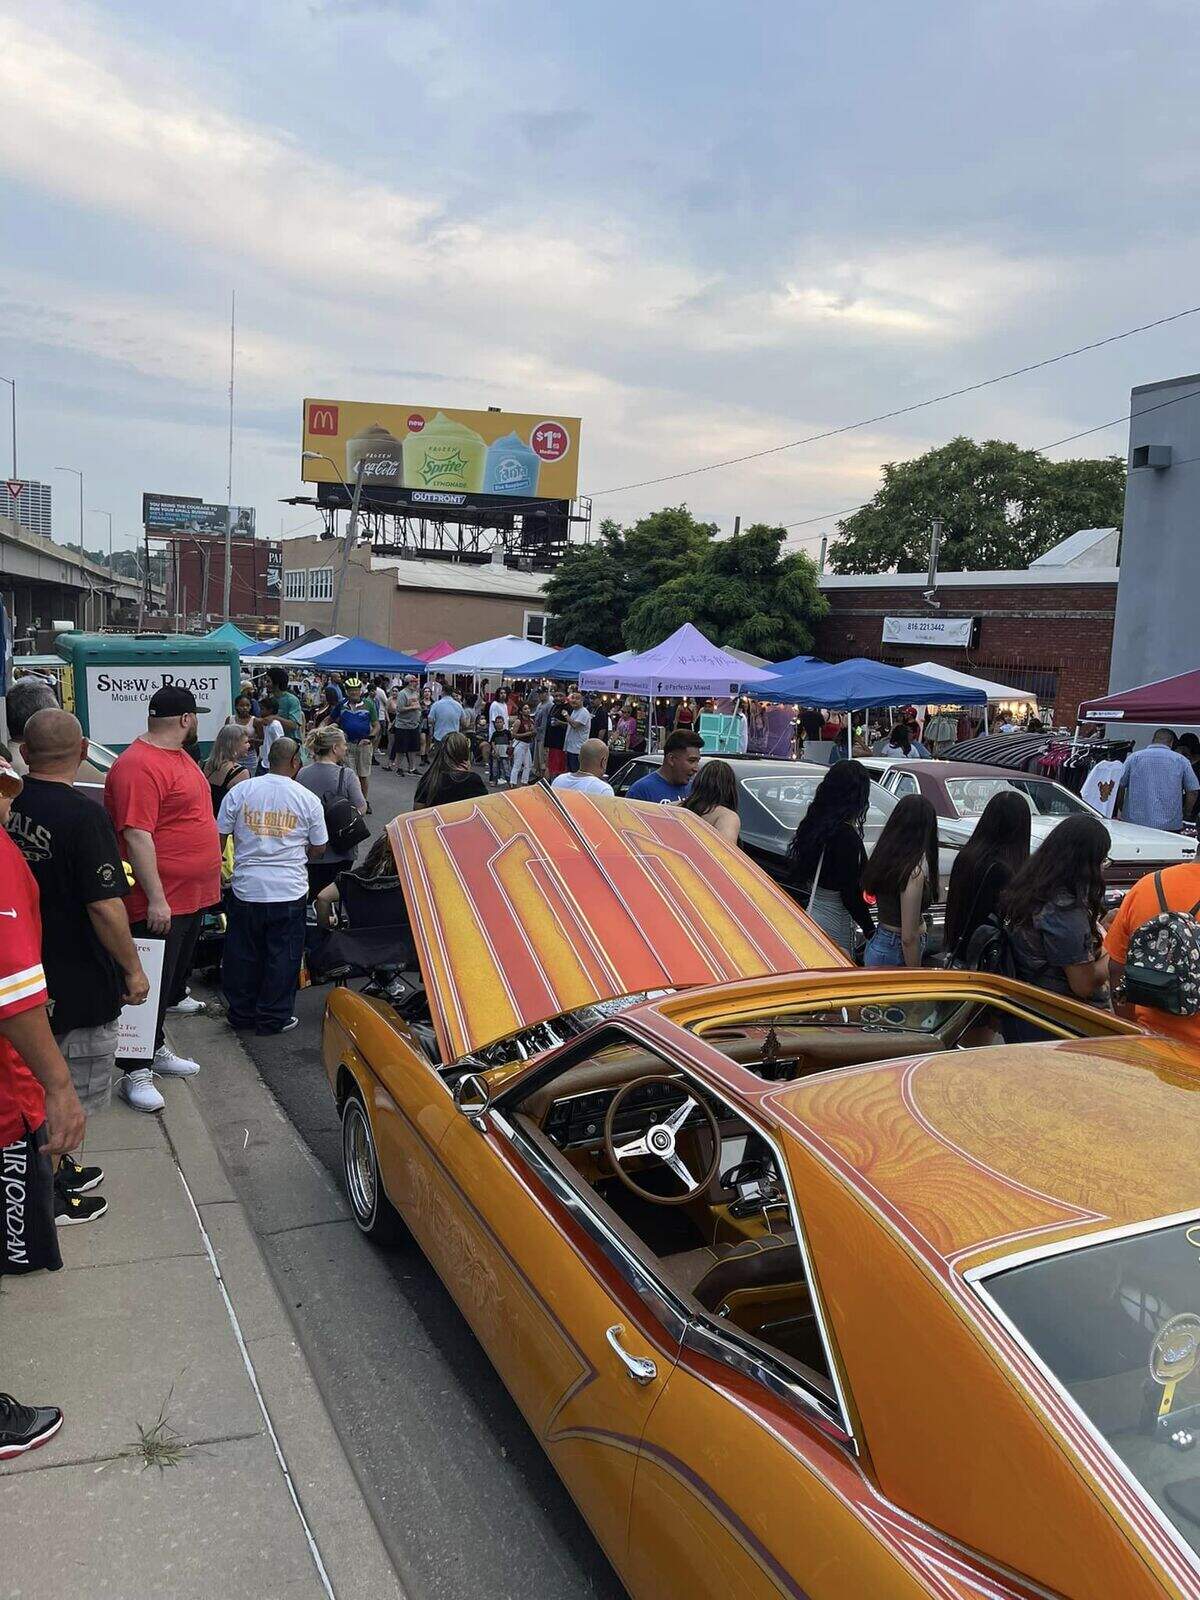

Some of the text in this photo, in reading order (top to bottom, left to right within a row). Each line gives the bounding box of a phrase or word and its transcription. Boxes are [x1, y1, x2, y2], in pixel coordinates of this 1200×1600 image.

[423, 460, 461, 475] Sprite
[413, 493, 464, 504] OUTFRONT
[161, 674, 218, 690] ROAST
[111, 693, 138, 701] MOBILE
[0, 1175, 29, 1264] JORDAN
